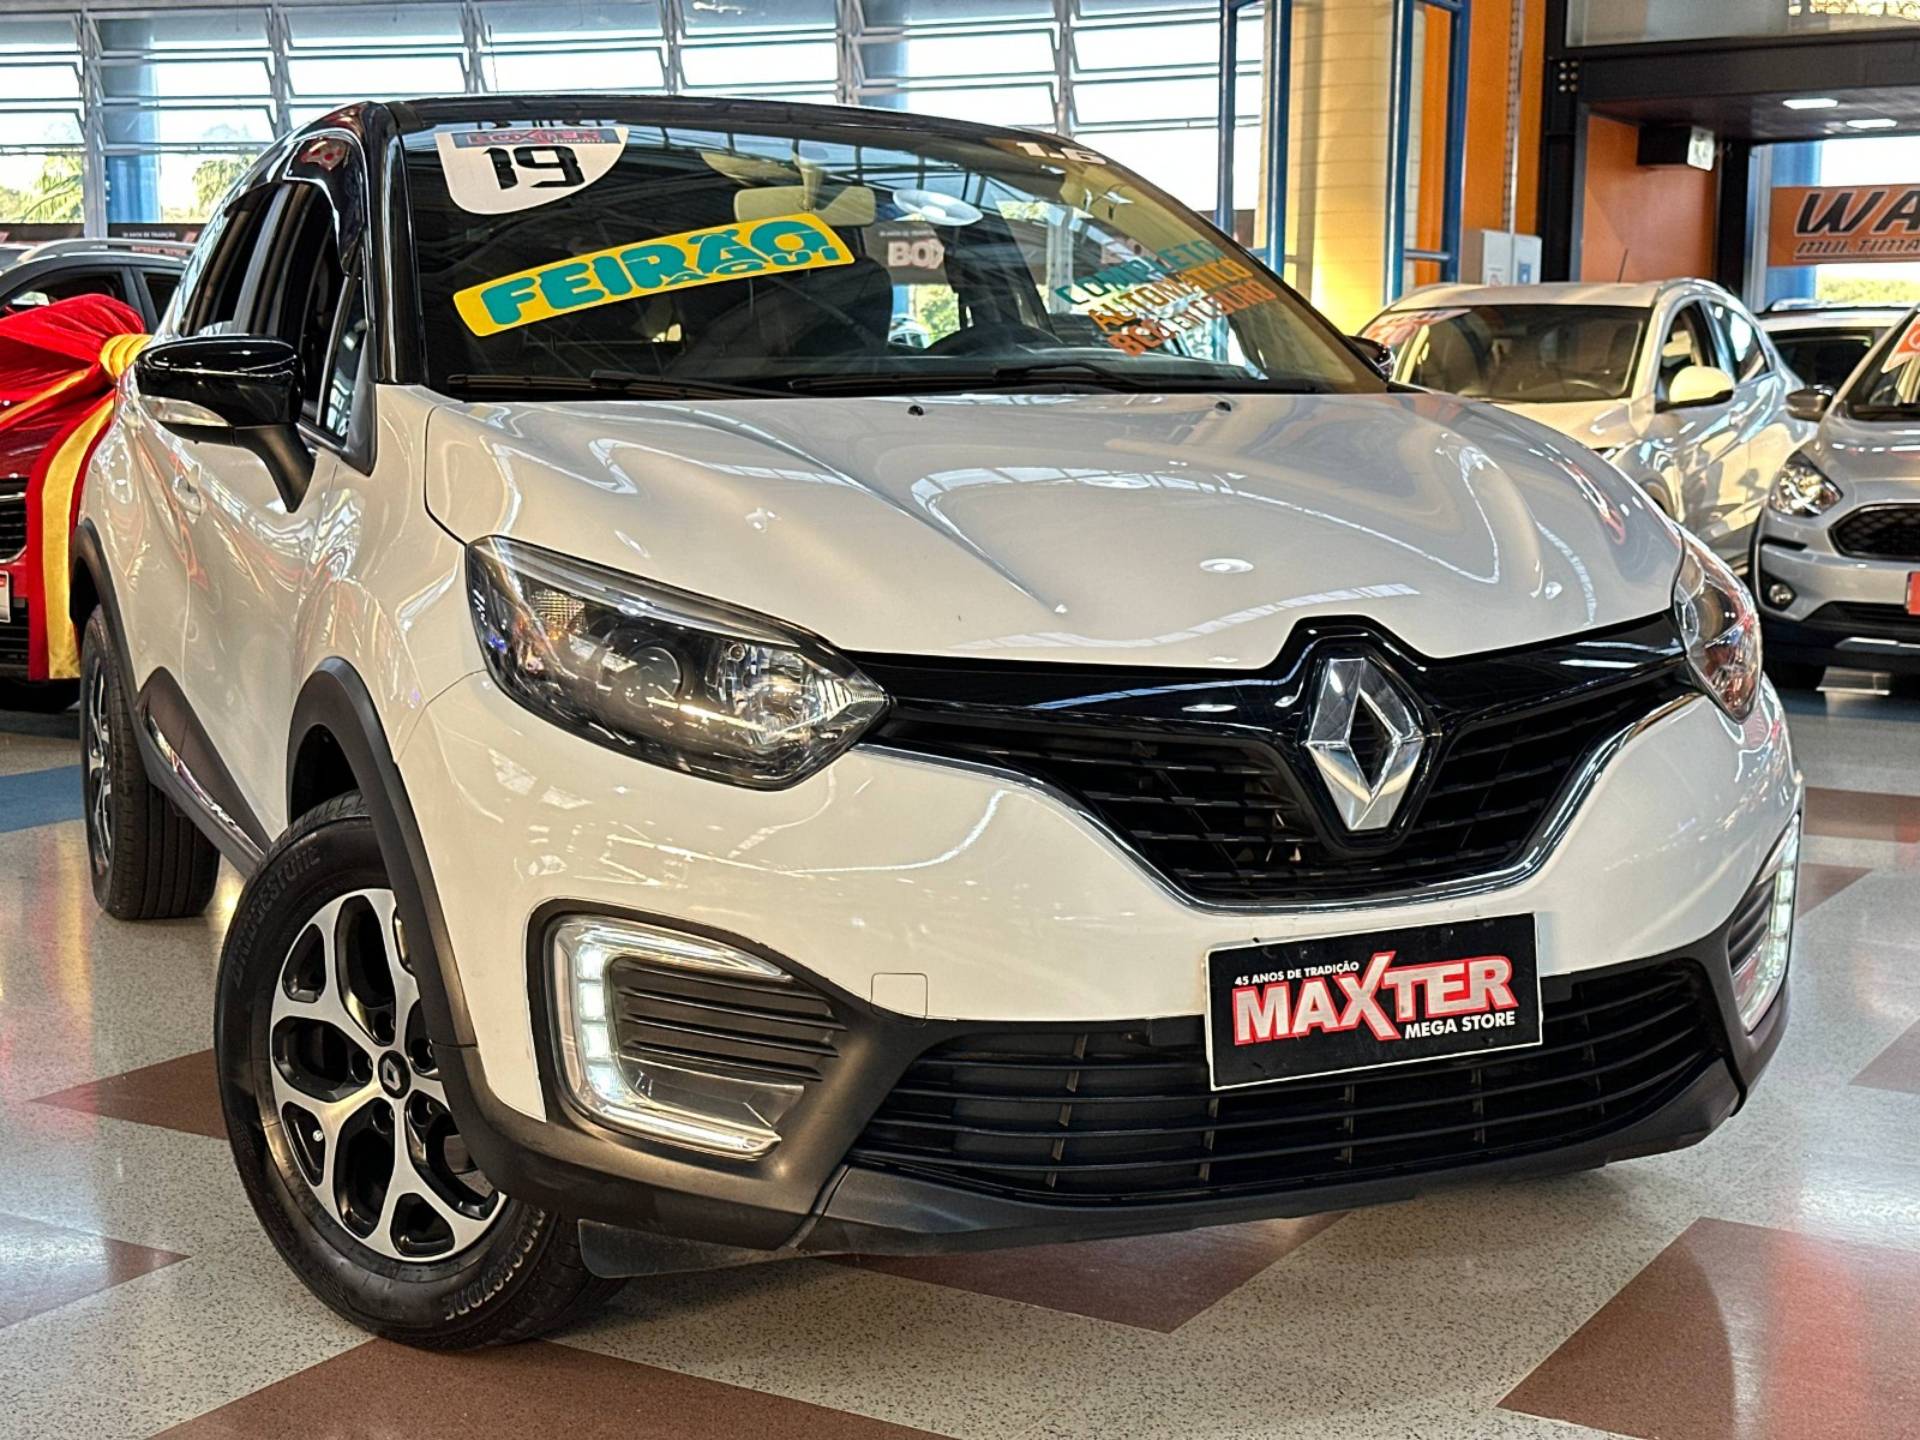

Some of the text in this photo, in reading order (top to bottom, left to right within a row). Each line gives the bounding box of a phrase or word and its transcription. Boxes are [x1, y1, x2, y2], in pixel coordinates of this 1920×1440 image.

[483, 145, 585, 190] 19
[481, 220, 830, 325] FEIRÃO
[1055, 240, 1225, 304] COMPLETO
[1231, 950, 1519, 1046] MAXTER
[1234, 960, 1360, 986] 45 ANOS DE TRADIÇÃO
[1404, 1011, 1516, 1039] MEGA STORE
